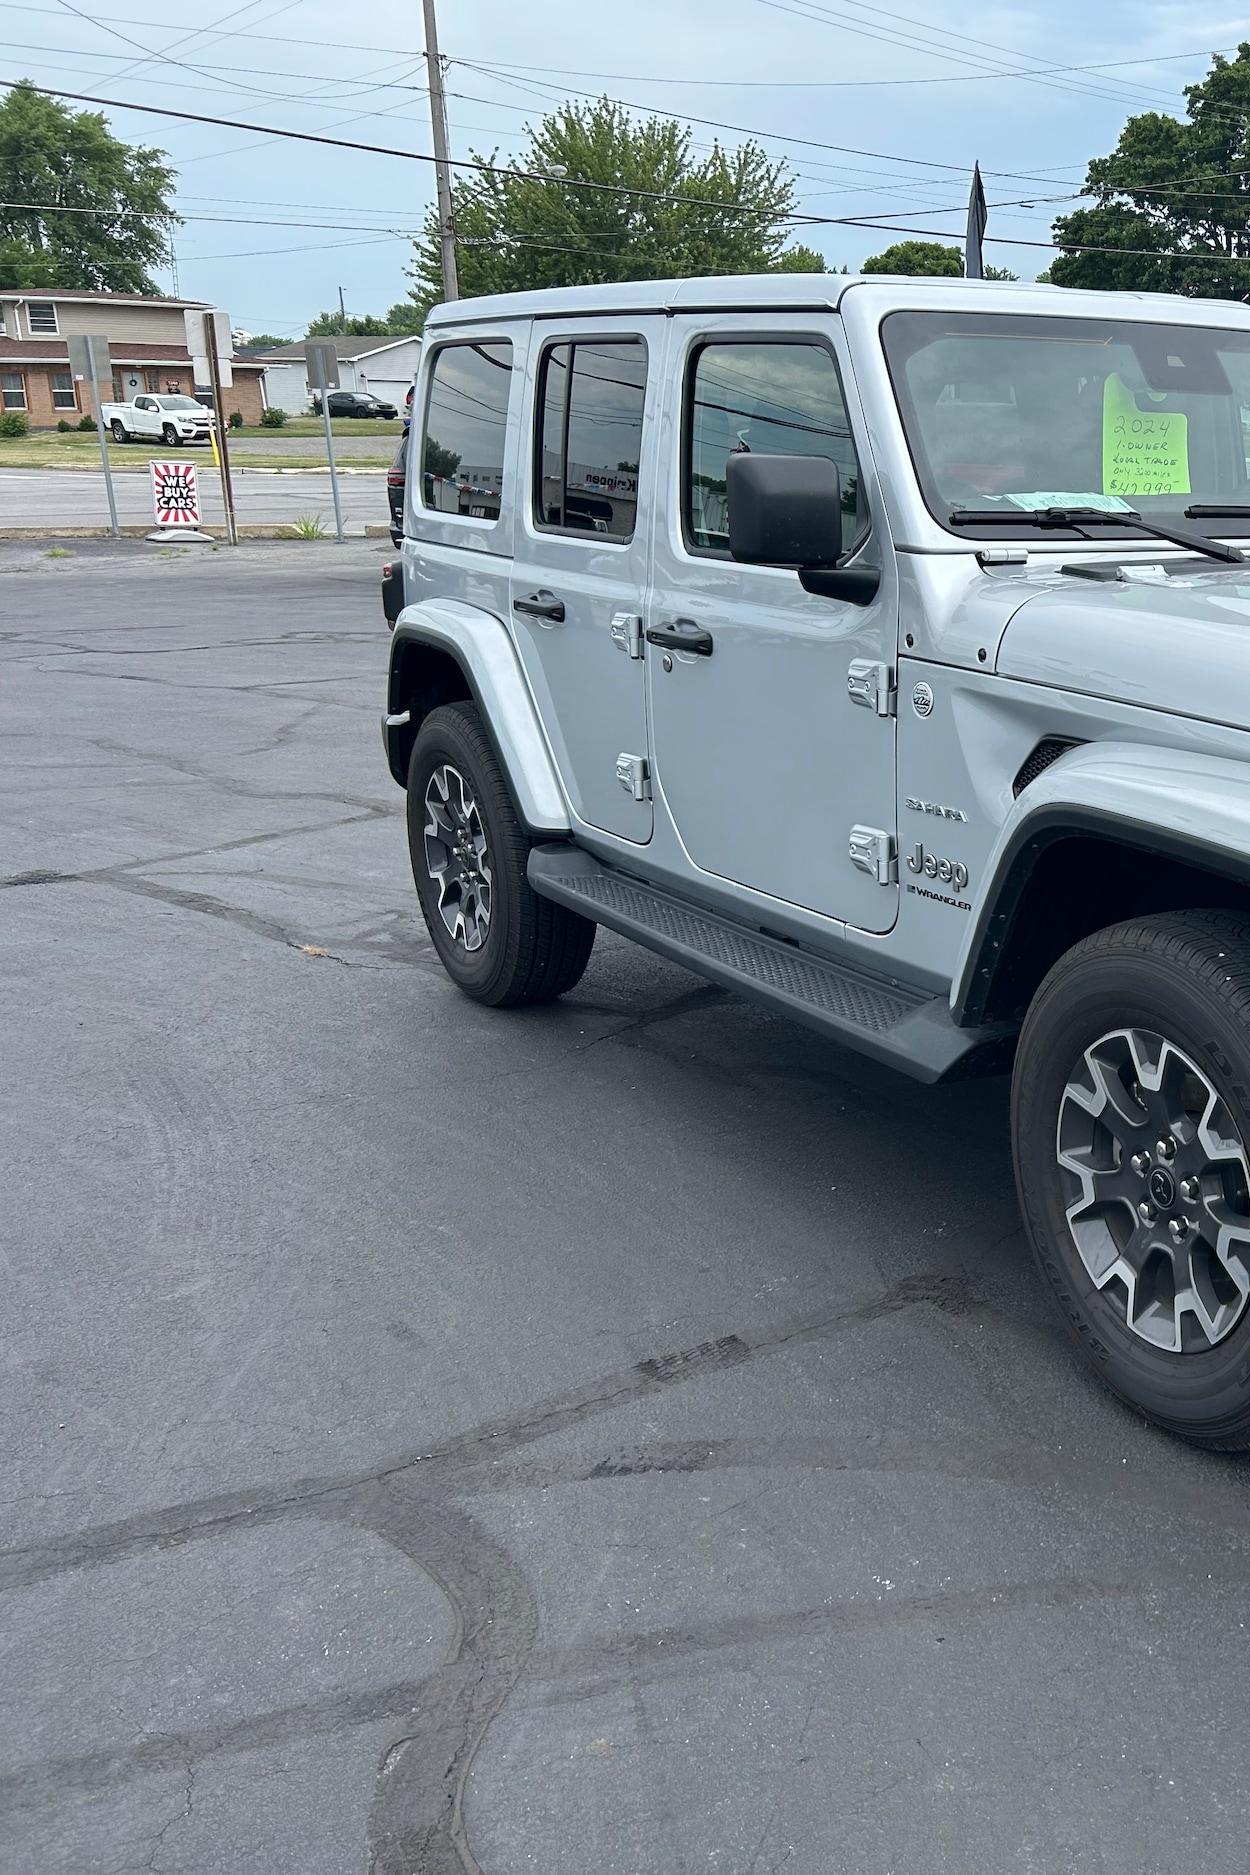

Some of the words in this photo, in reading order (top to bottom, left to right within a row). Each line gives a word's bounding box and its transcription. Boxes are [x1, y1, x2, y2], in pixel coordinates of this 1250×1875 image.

[1113, 415, 1171, 438] 2024
[163, 475, 187, 487] WE
[163, 486, 190, 498] BUY
[159, 497, 194, 509] CARS
[905, 797, 969, 823] SAHARA
[905, 841, 969, 893] Jeep
[916, 886, 972, 912] WRANGLER
